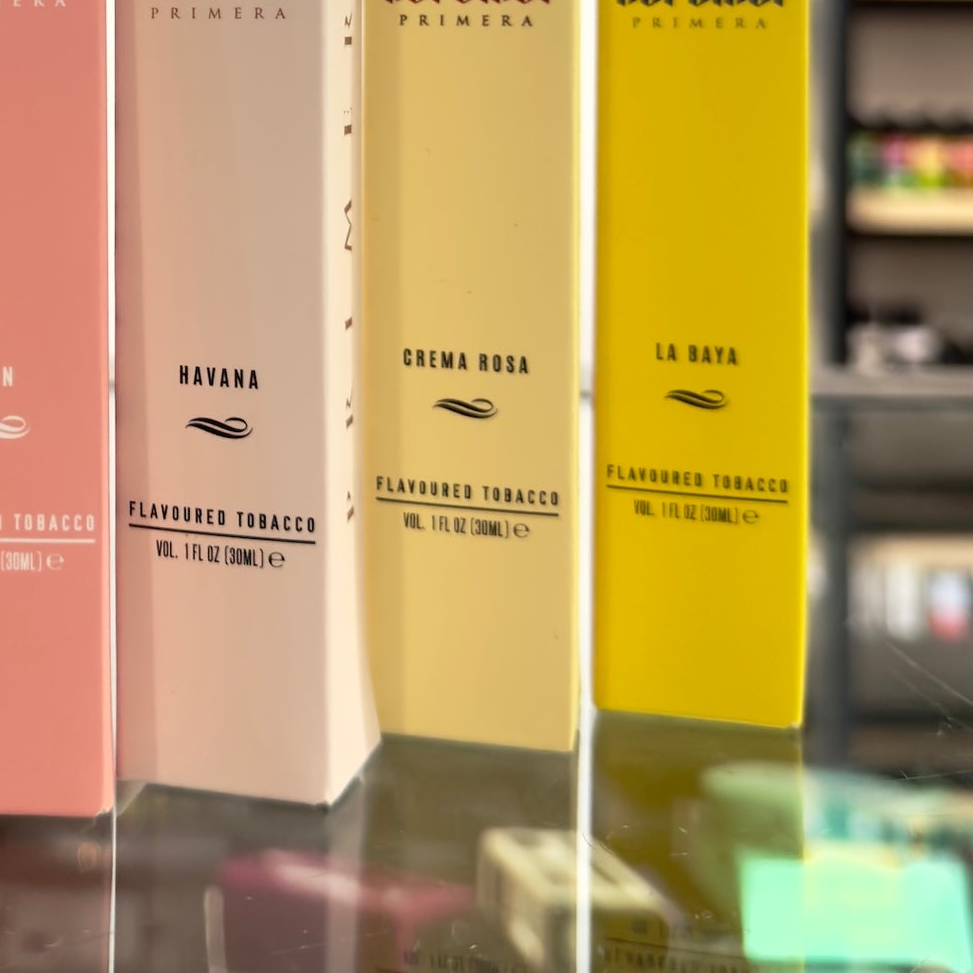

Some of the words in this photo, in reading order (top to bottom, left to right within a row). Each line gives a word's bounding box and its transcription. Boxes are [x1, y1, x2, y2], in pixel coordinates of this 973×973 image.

[151, 7, 286, 20] PRIMERA
[399, 14, 533, 27] PRIMERA
[633, 17, 766, 29] PRIMERA
[403, 348, 467, 370] CREMA
[479, 353, 529, 374] ROSA
[656, 342, 677, 361] LA
[688, 344, 738, 365] BAYA
[179, 365, 259, 389] HAVANA
[606, 464, 702, 487] FLAVOURED
[713, 474, 788, 493] TOBACCO
[376, 476, 471, 499] FLAVOURED
[482, 486, 558, 506] TOBACCO
[14, 513, 95, 531] TOBACCO
[129, 500, 225, 526] FLAVOURED
[237, 511, 315, 533] TOBACCO
[439, 515, 450, 533] FL
[454, 516, 466, 534] OZ
[156, 539, 178, 559] VOL.
[192, 543, 203, 562] FL
[207, 545, 220, 563] OZ
